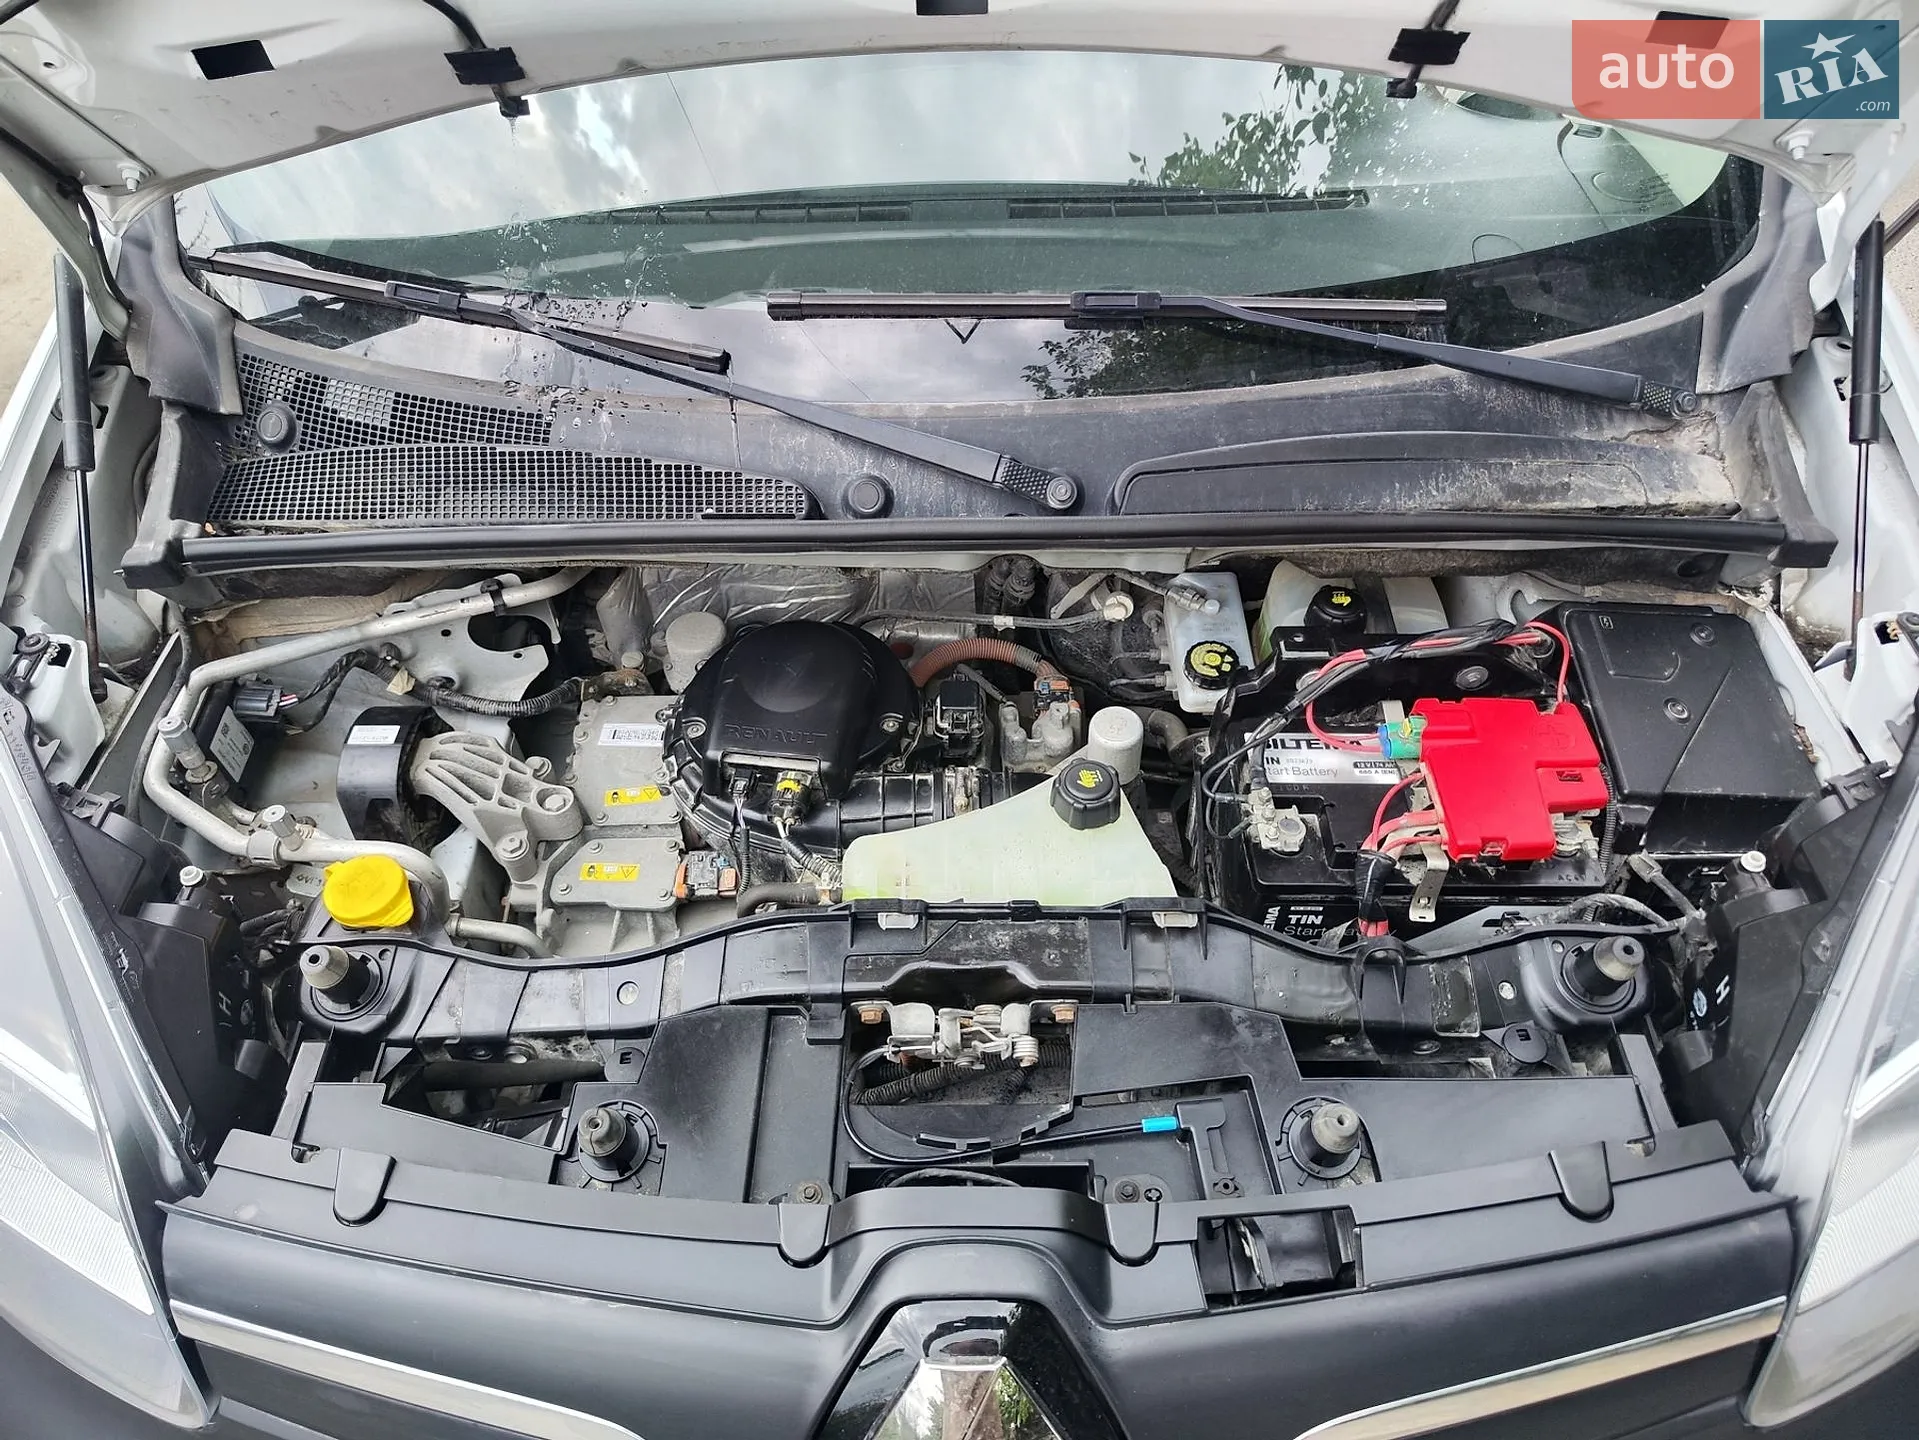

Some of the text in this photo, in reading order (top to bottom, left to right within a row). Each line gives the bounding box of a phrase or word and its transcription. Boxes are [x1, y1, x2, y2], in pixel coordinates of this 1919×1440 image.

[724, 723, 828, 744] RENAULT
[1266, 757, 1280, 765] IN
[1268, 767, 1338, 778] tart Battery
[1263, 906, 1281, 930] EMA
[1288, 914, 1323, 925] TIN
[1283, 925, 1326, 936] Start
